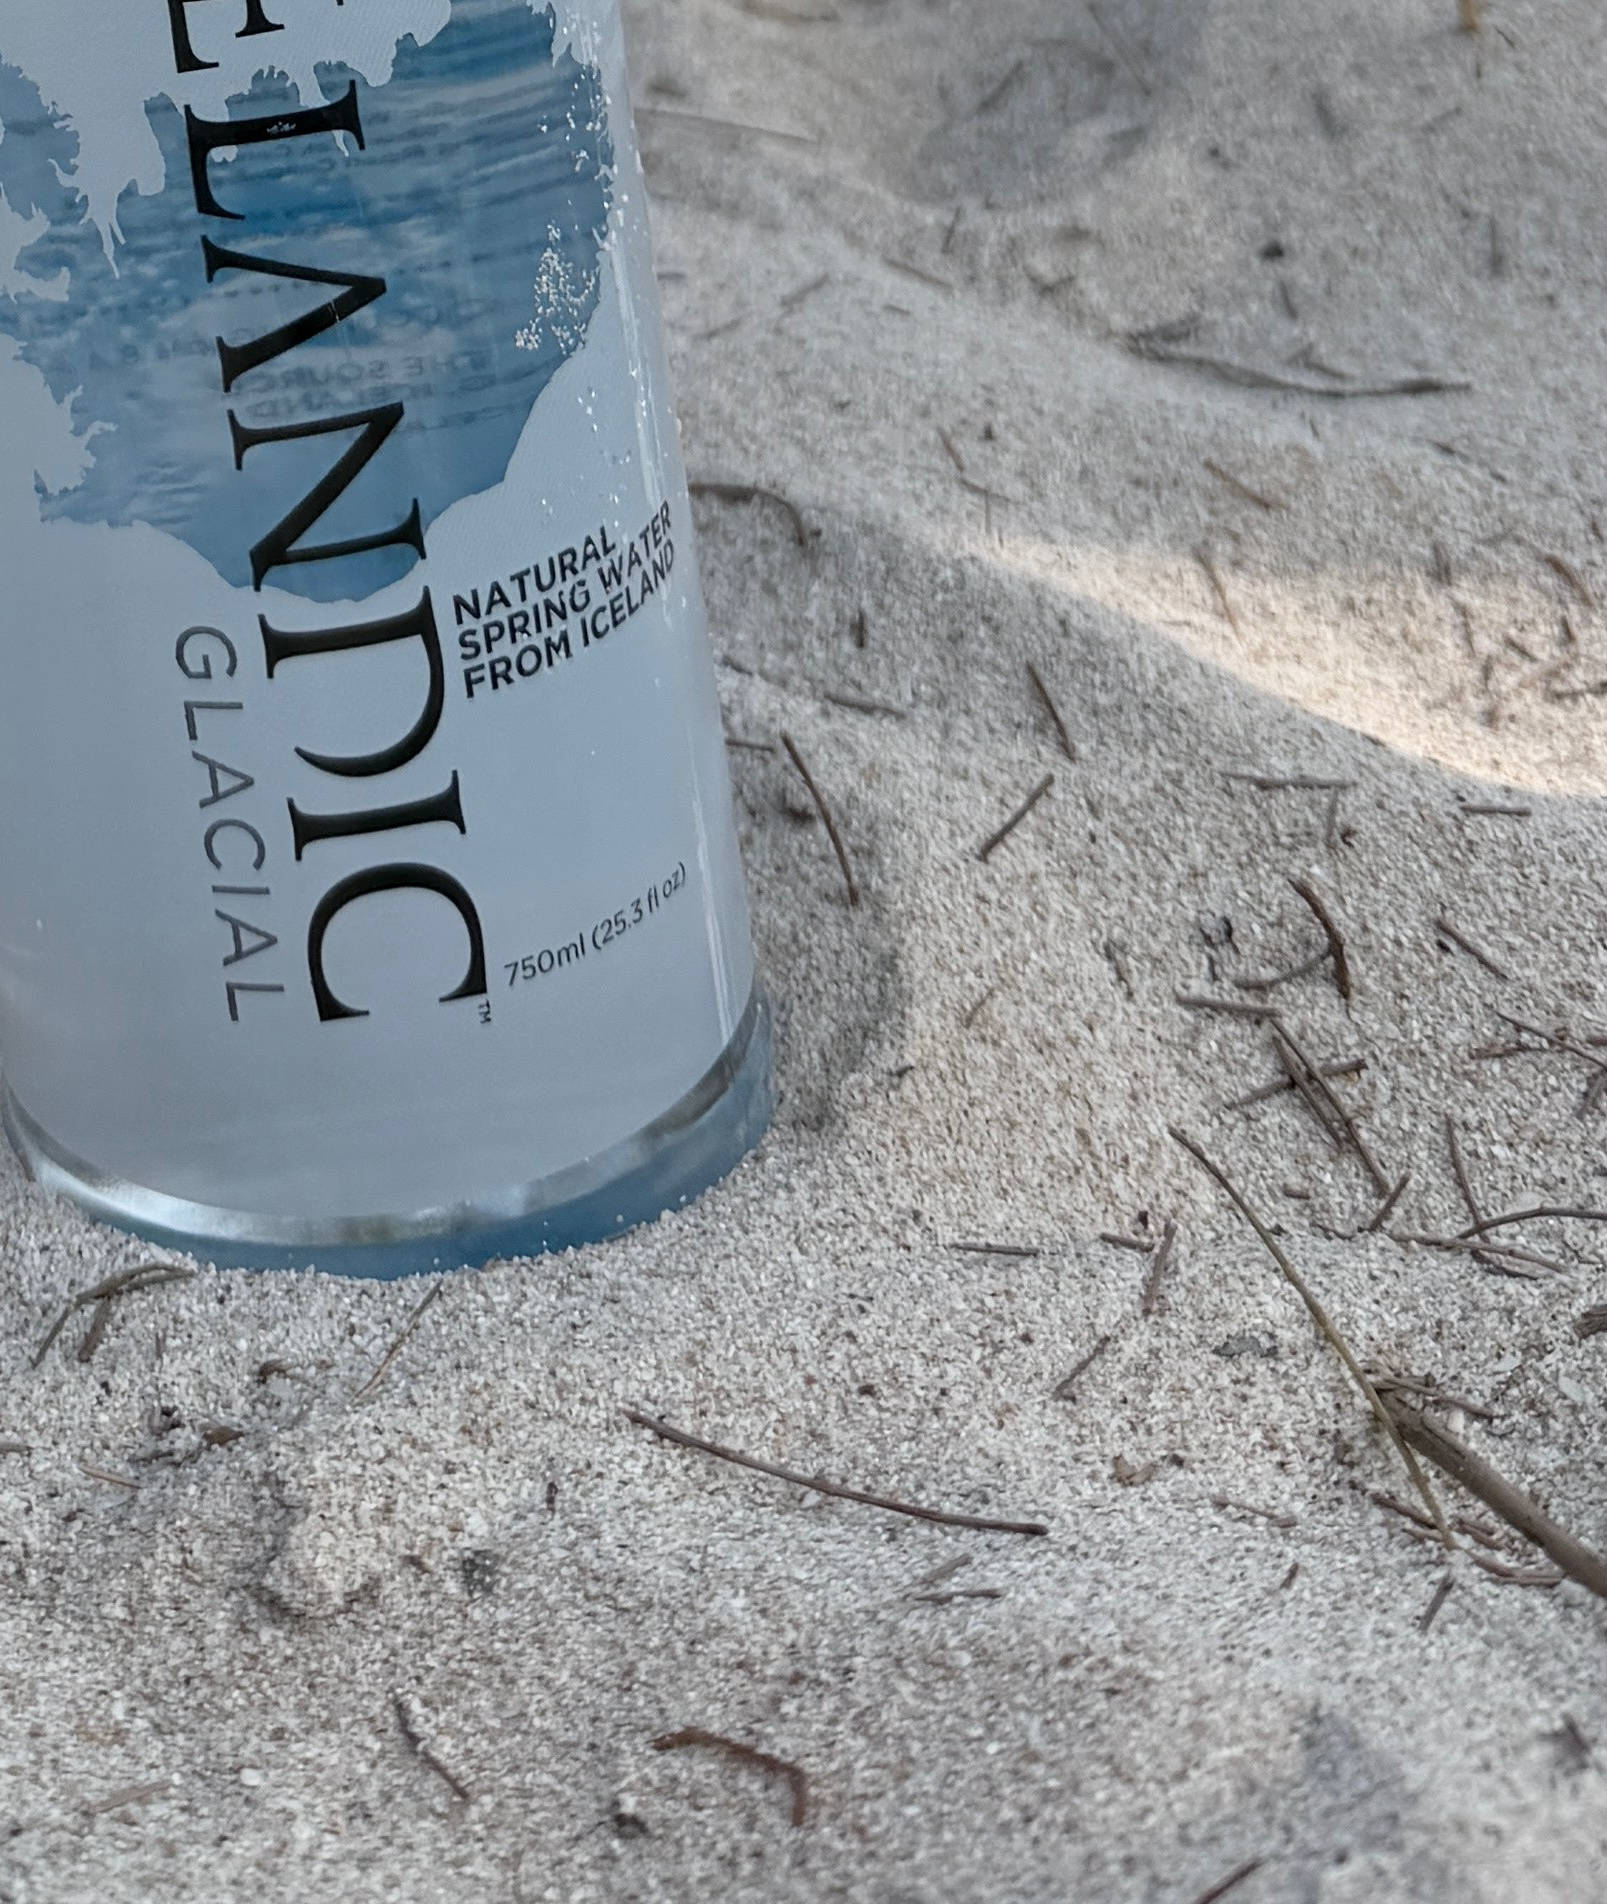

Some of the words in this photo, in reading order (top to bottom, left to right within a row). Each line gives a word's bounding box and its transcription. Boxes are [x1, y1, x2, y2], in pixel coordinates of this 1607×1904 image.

[453, 525, 616, 625] NATURAL
[458, 579, 591, 661] SPRING
[598, 500, 672, 594] WATER
[463, 628, 573, 699] FROM
[580, 538, 675, 647] ICELAND
[175, 625, 285, 1022] GLACIAL
[504, 932, 586, 987] 750ml
[592, 897, 644, 951] (25.3
[662, 861, 686, 898] oz)
